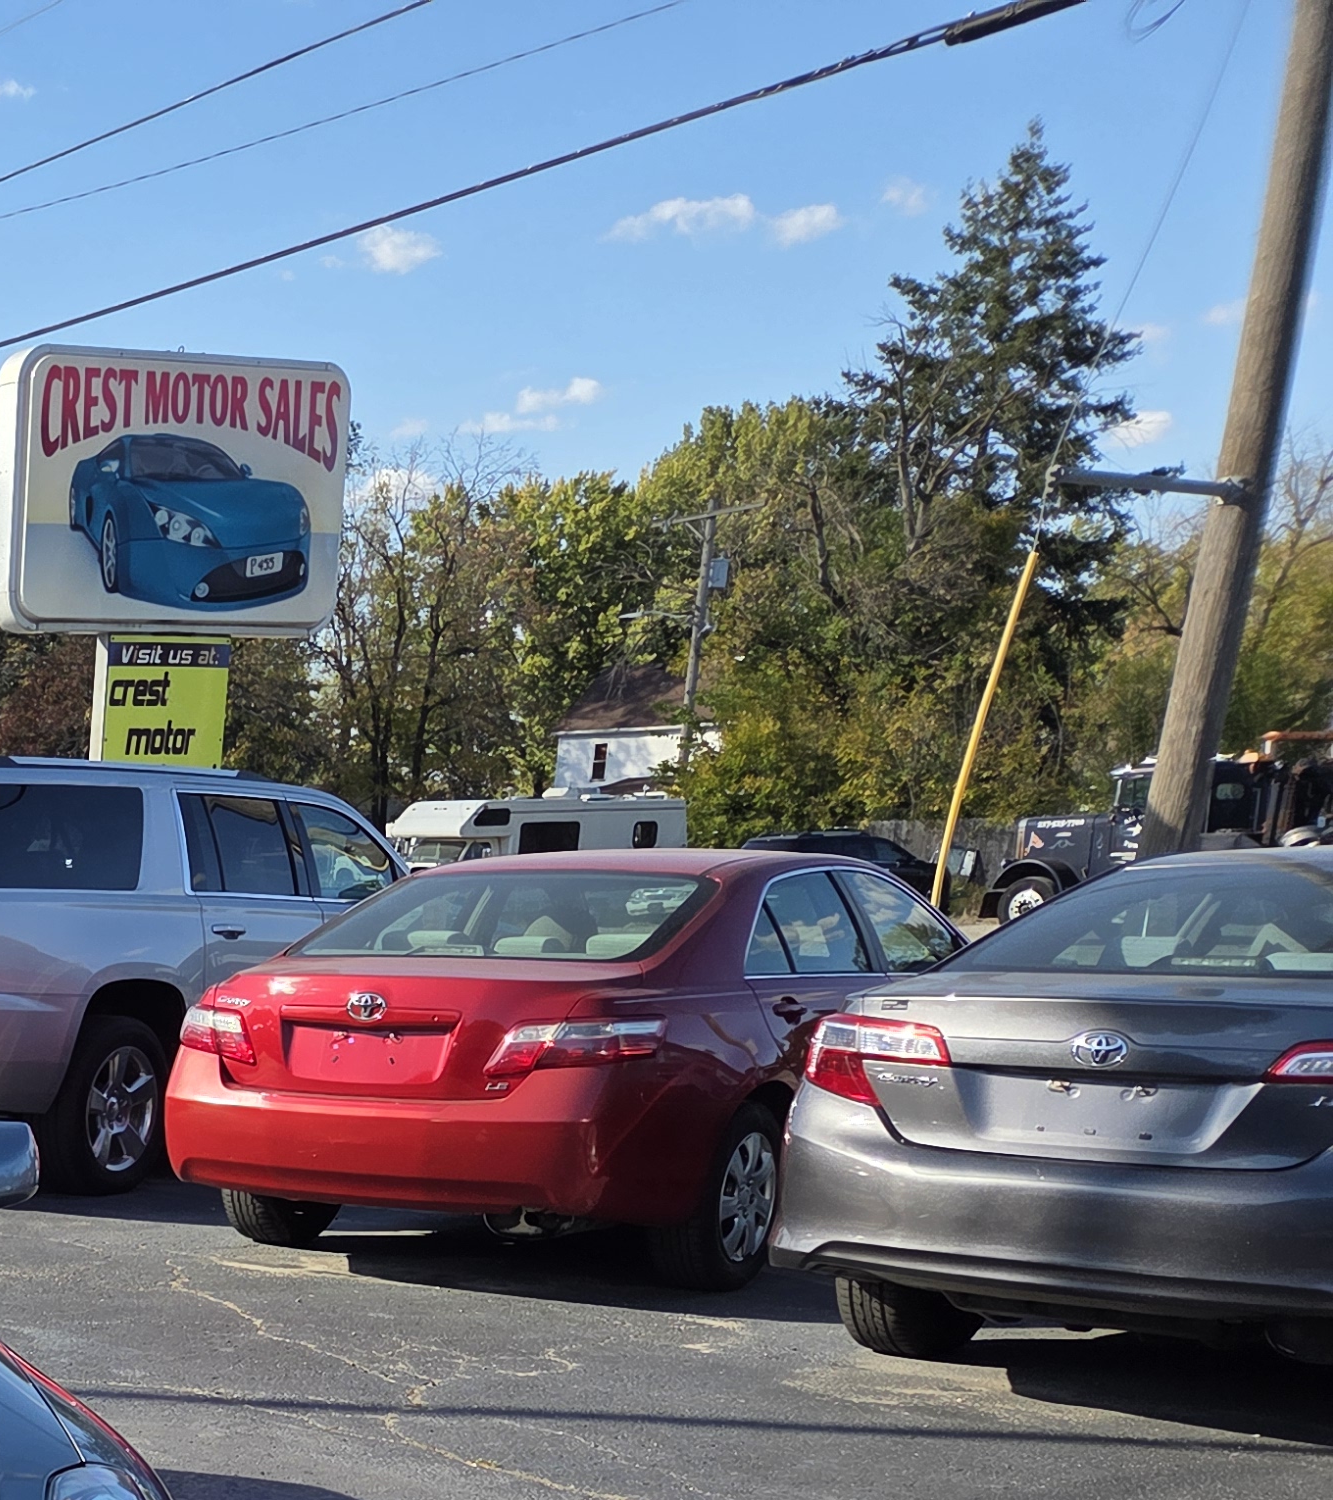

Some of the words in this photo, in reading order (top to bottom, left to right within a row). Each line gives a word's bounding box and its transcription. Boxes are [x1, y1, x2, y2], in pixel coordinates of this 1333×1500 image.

[41, 364, 138, 457] CREST
[145, 371, 248, 431] MOTOR
[257, 376, 341, 472] SALES
[121, 645, 162, 664] Visit
[167, 650, 192, 664] us
[198, 647, 219, 665] at:
[108, 671, 170, 707] crest
[124, 720, 196, 756] motor
[485, 1082, 510, 1091] LE
